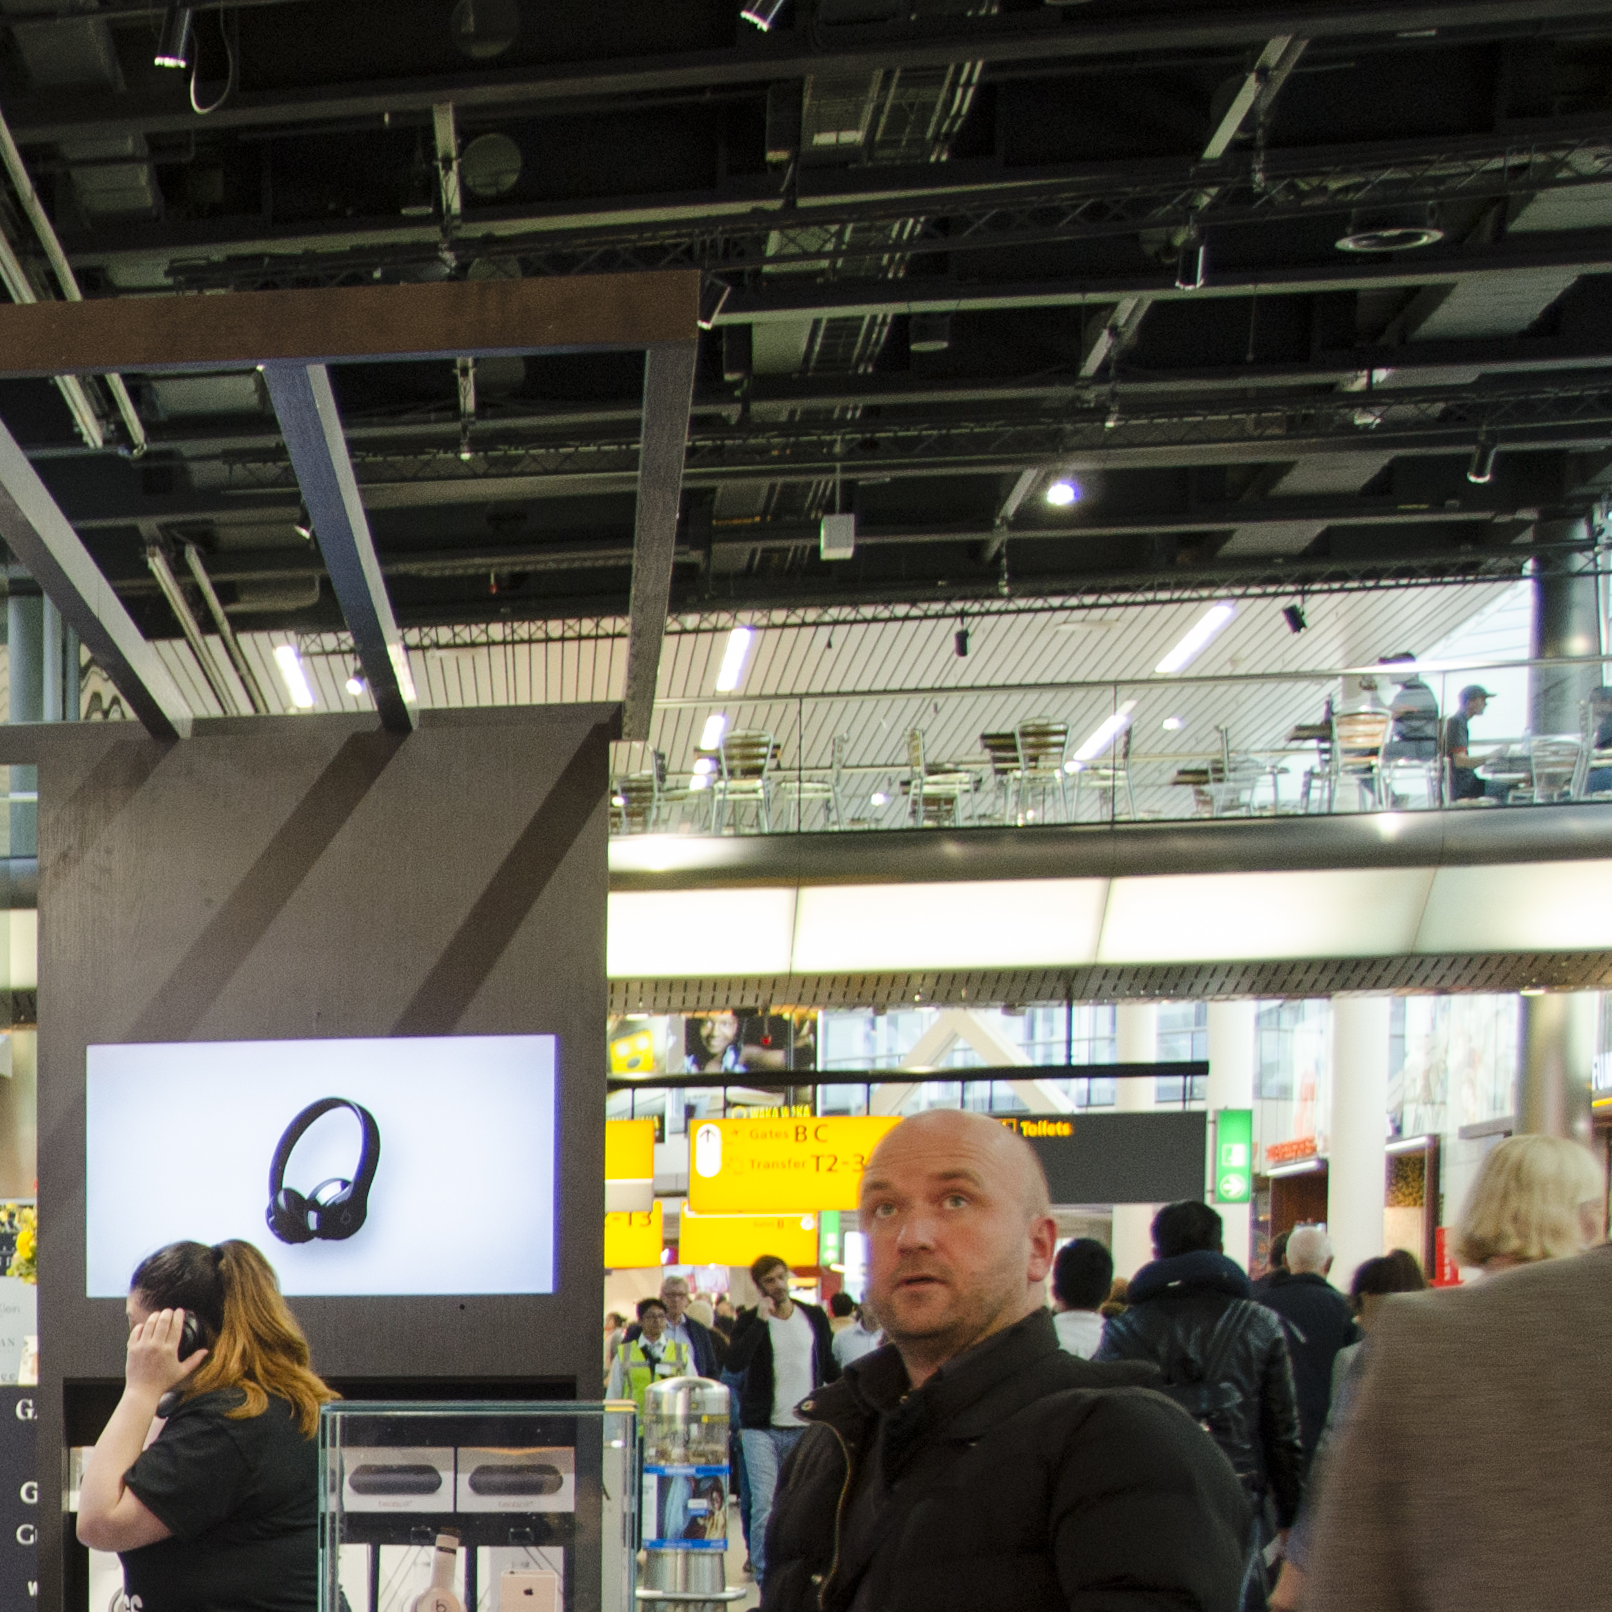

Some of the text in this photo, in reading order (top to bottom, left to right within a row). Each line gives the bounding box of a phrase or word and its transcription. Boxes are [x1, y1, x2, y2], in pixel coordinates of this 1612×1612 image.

[749, 1124, 829, 1143] Gates B C
[1020, 1120, 1073, 1137] Toilets
[749, 1158, 807, 1170] Transfer
